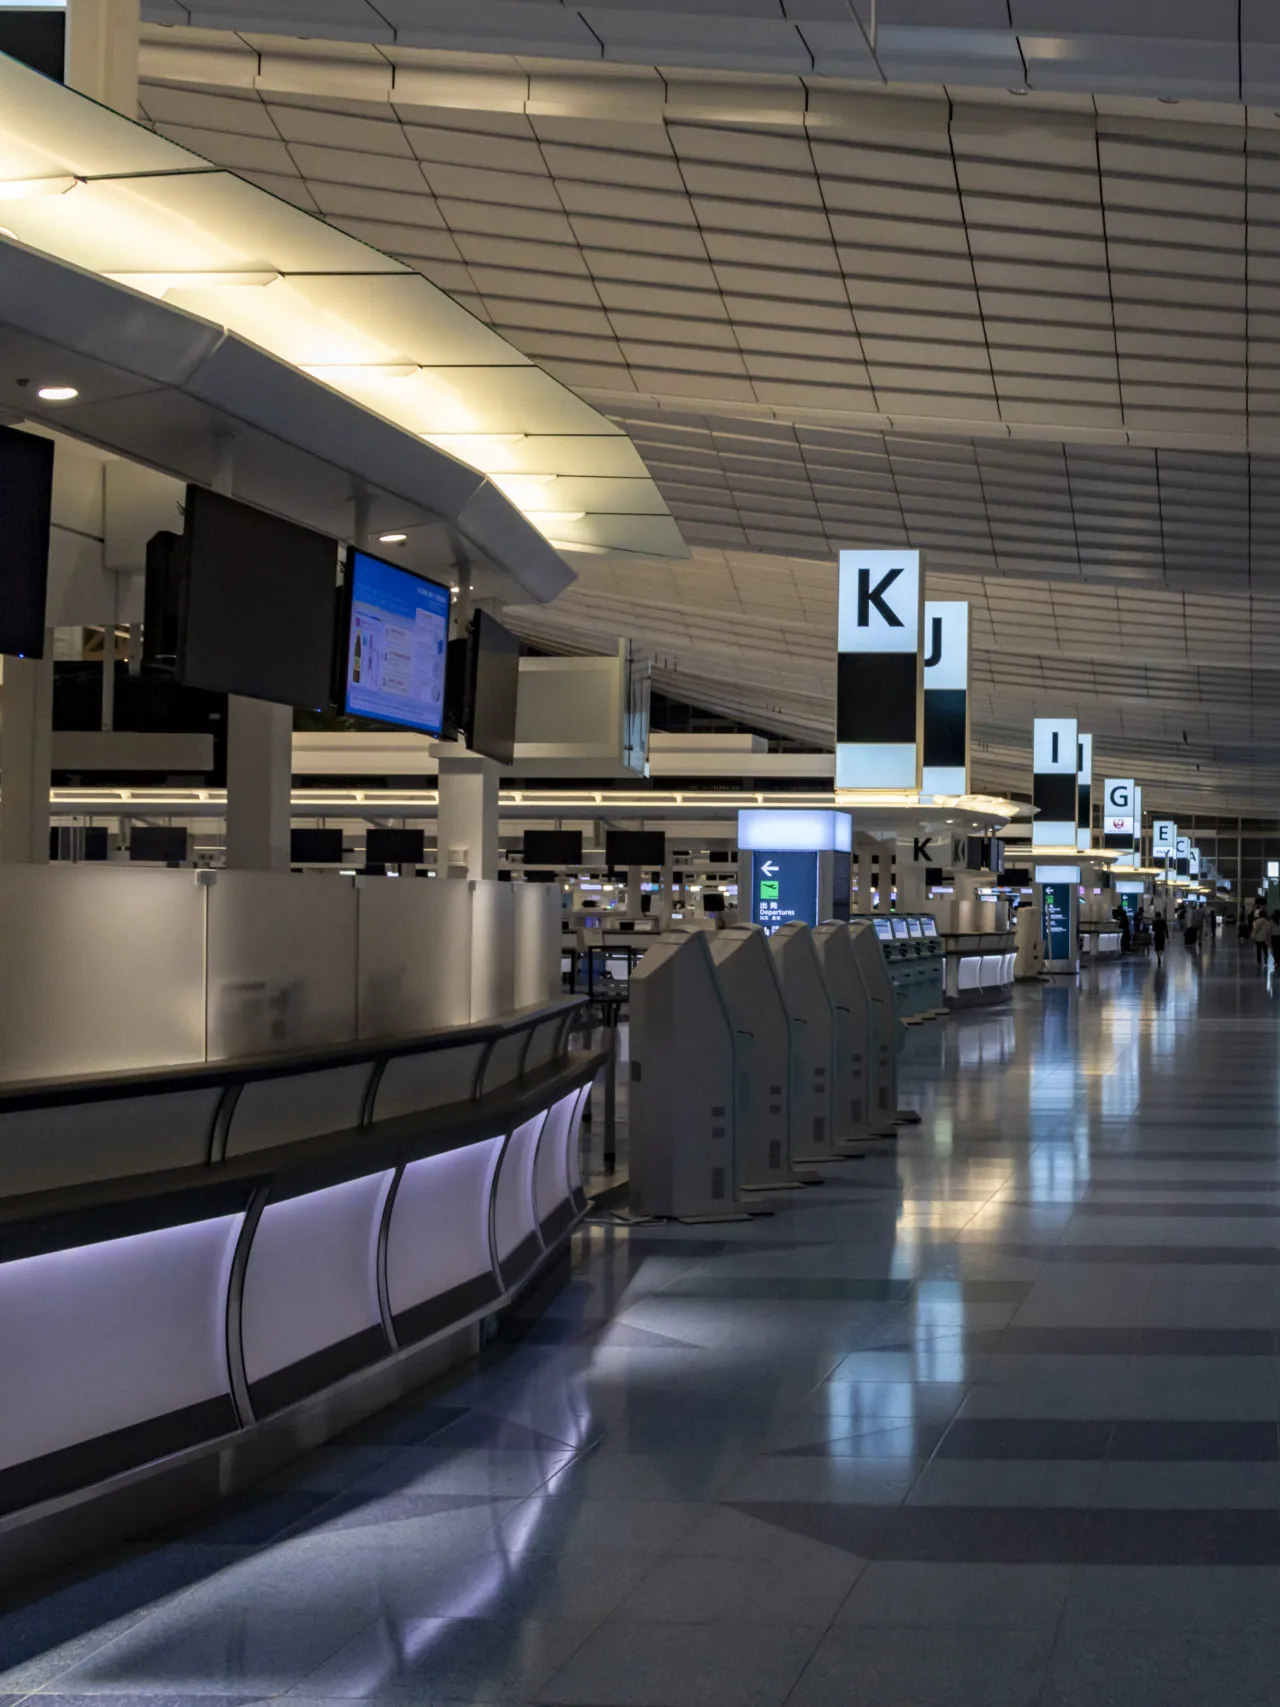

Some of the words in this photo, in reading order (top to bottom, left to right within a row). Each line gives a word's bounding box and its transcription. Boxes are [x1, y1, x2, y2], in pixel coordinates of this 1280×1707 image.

[856, 568, 905, 627] K
[924, 617, 943, 668] J
[1051, 731, 1059, 763] I
[1110, 786, 1129, 807] G
[1160, 826, 1168, 841] E
[914, 837, 933, 862] K
[1177, 841, 1184, 853] C
[1190, 852, 1196, 861] A
